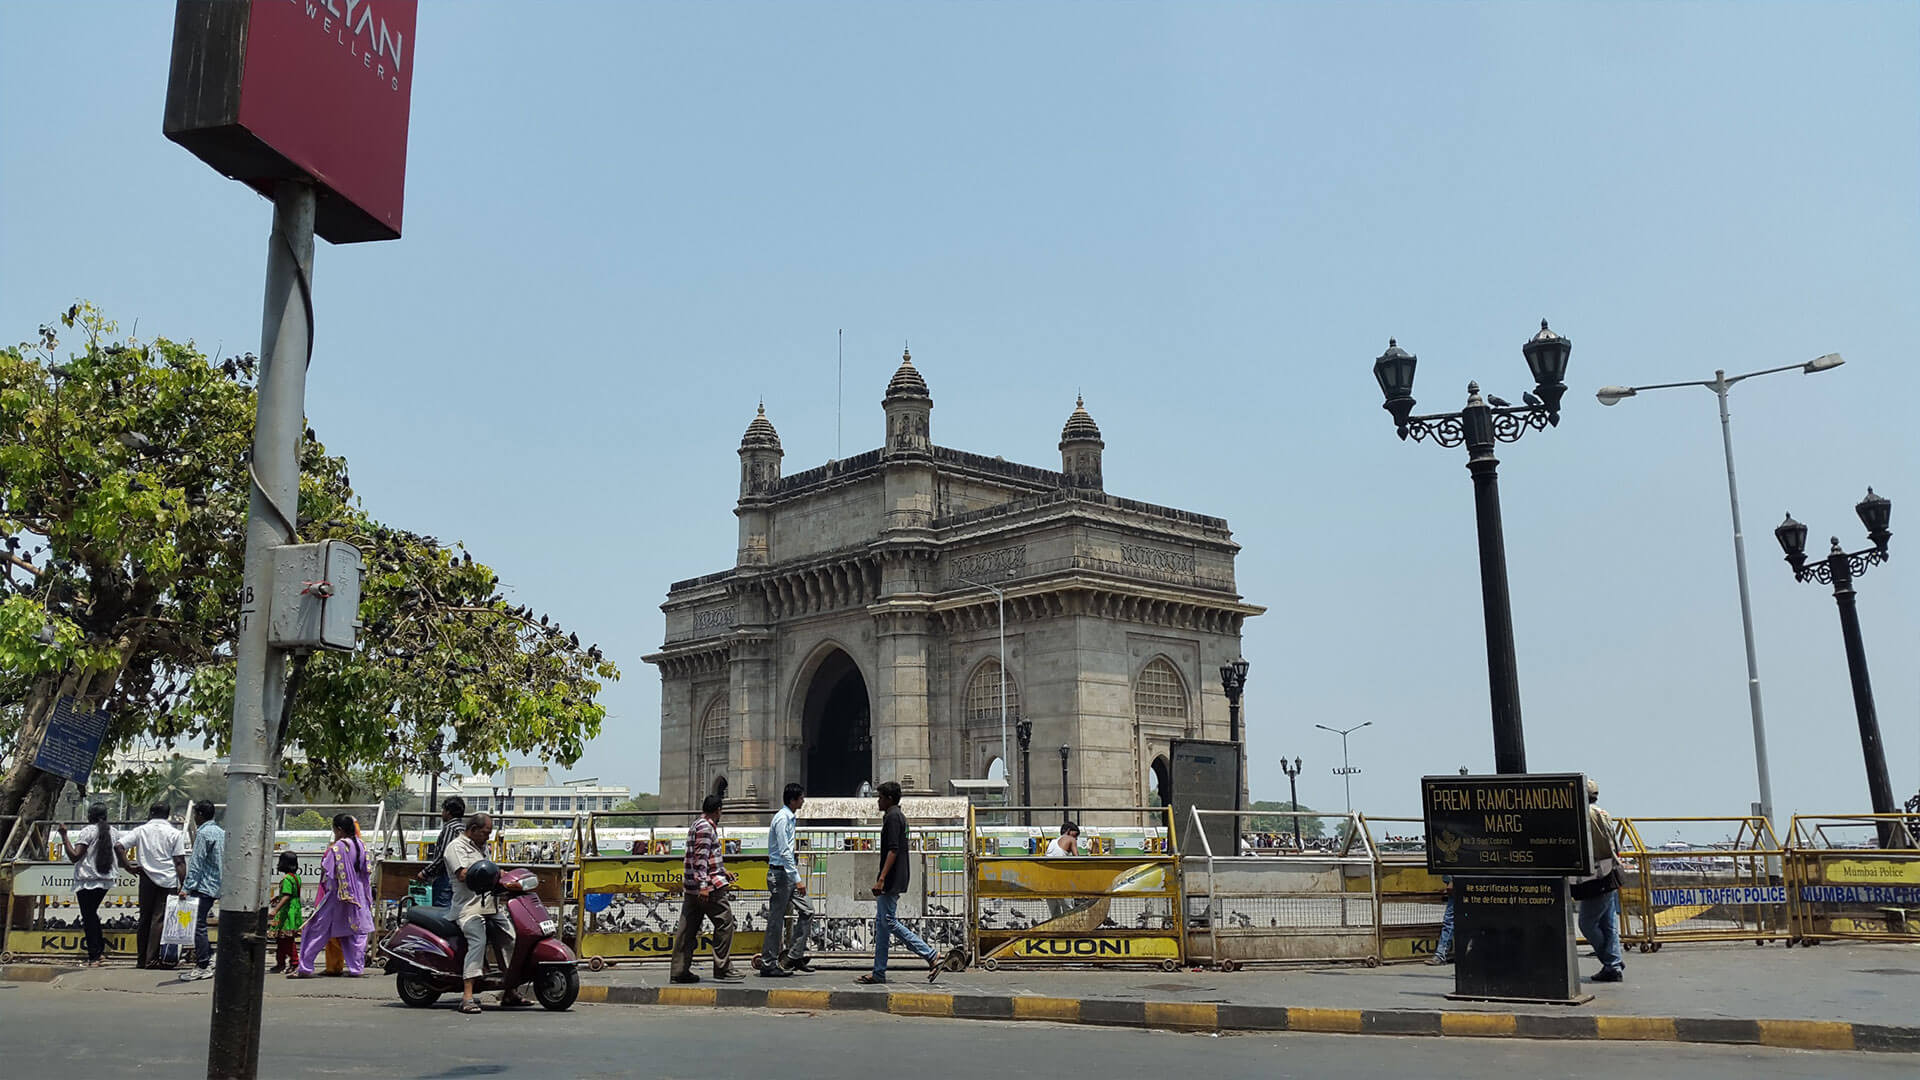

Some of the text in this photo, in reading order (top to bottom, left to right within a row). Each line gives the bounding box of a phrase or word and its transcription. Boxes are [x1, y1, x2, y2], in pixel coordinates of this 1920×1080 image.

[290, 0, 398, 91] WELLERS
[1433, 787, 1574, 811] PREM RAMCHANDANI
[1484, 814, 1523, 833] MARG
[625, 870, 683, 883] Mumba
[1843, 866, 1904, 878] Mumbai Police
[1475, 884, 1509, 893] sacrificed
[1520, 885, 1539, 894] young
[1652, 886, 1786, 905] MUMBAI TRAFFIC POLICE
[1802, 886, 1860, 902] MUMBAI
[1471, 896, 1481, 904] the
[1482, 896, 1508, 904] defence
[1025, 939, 1131, 954] KUONI
